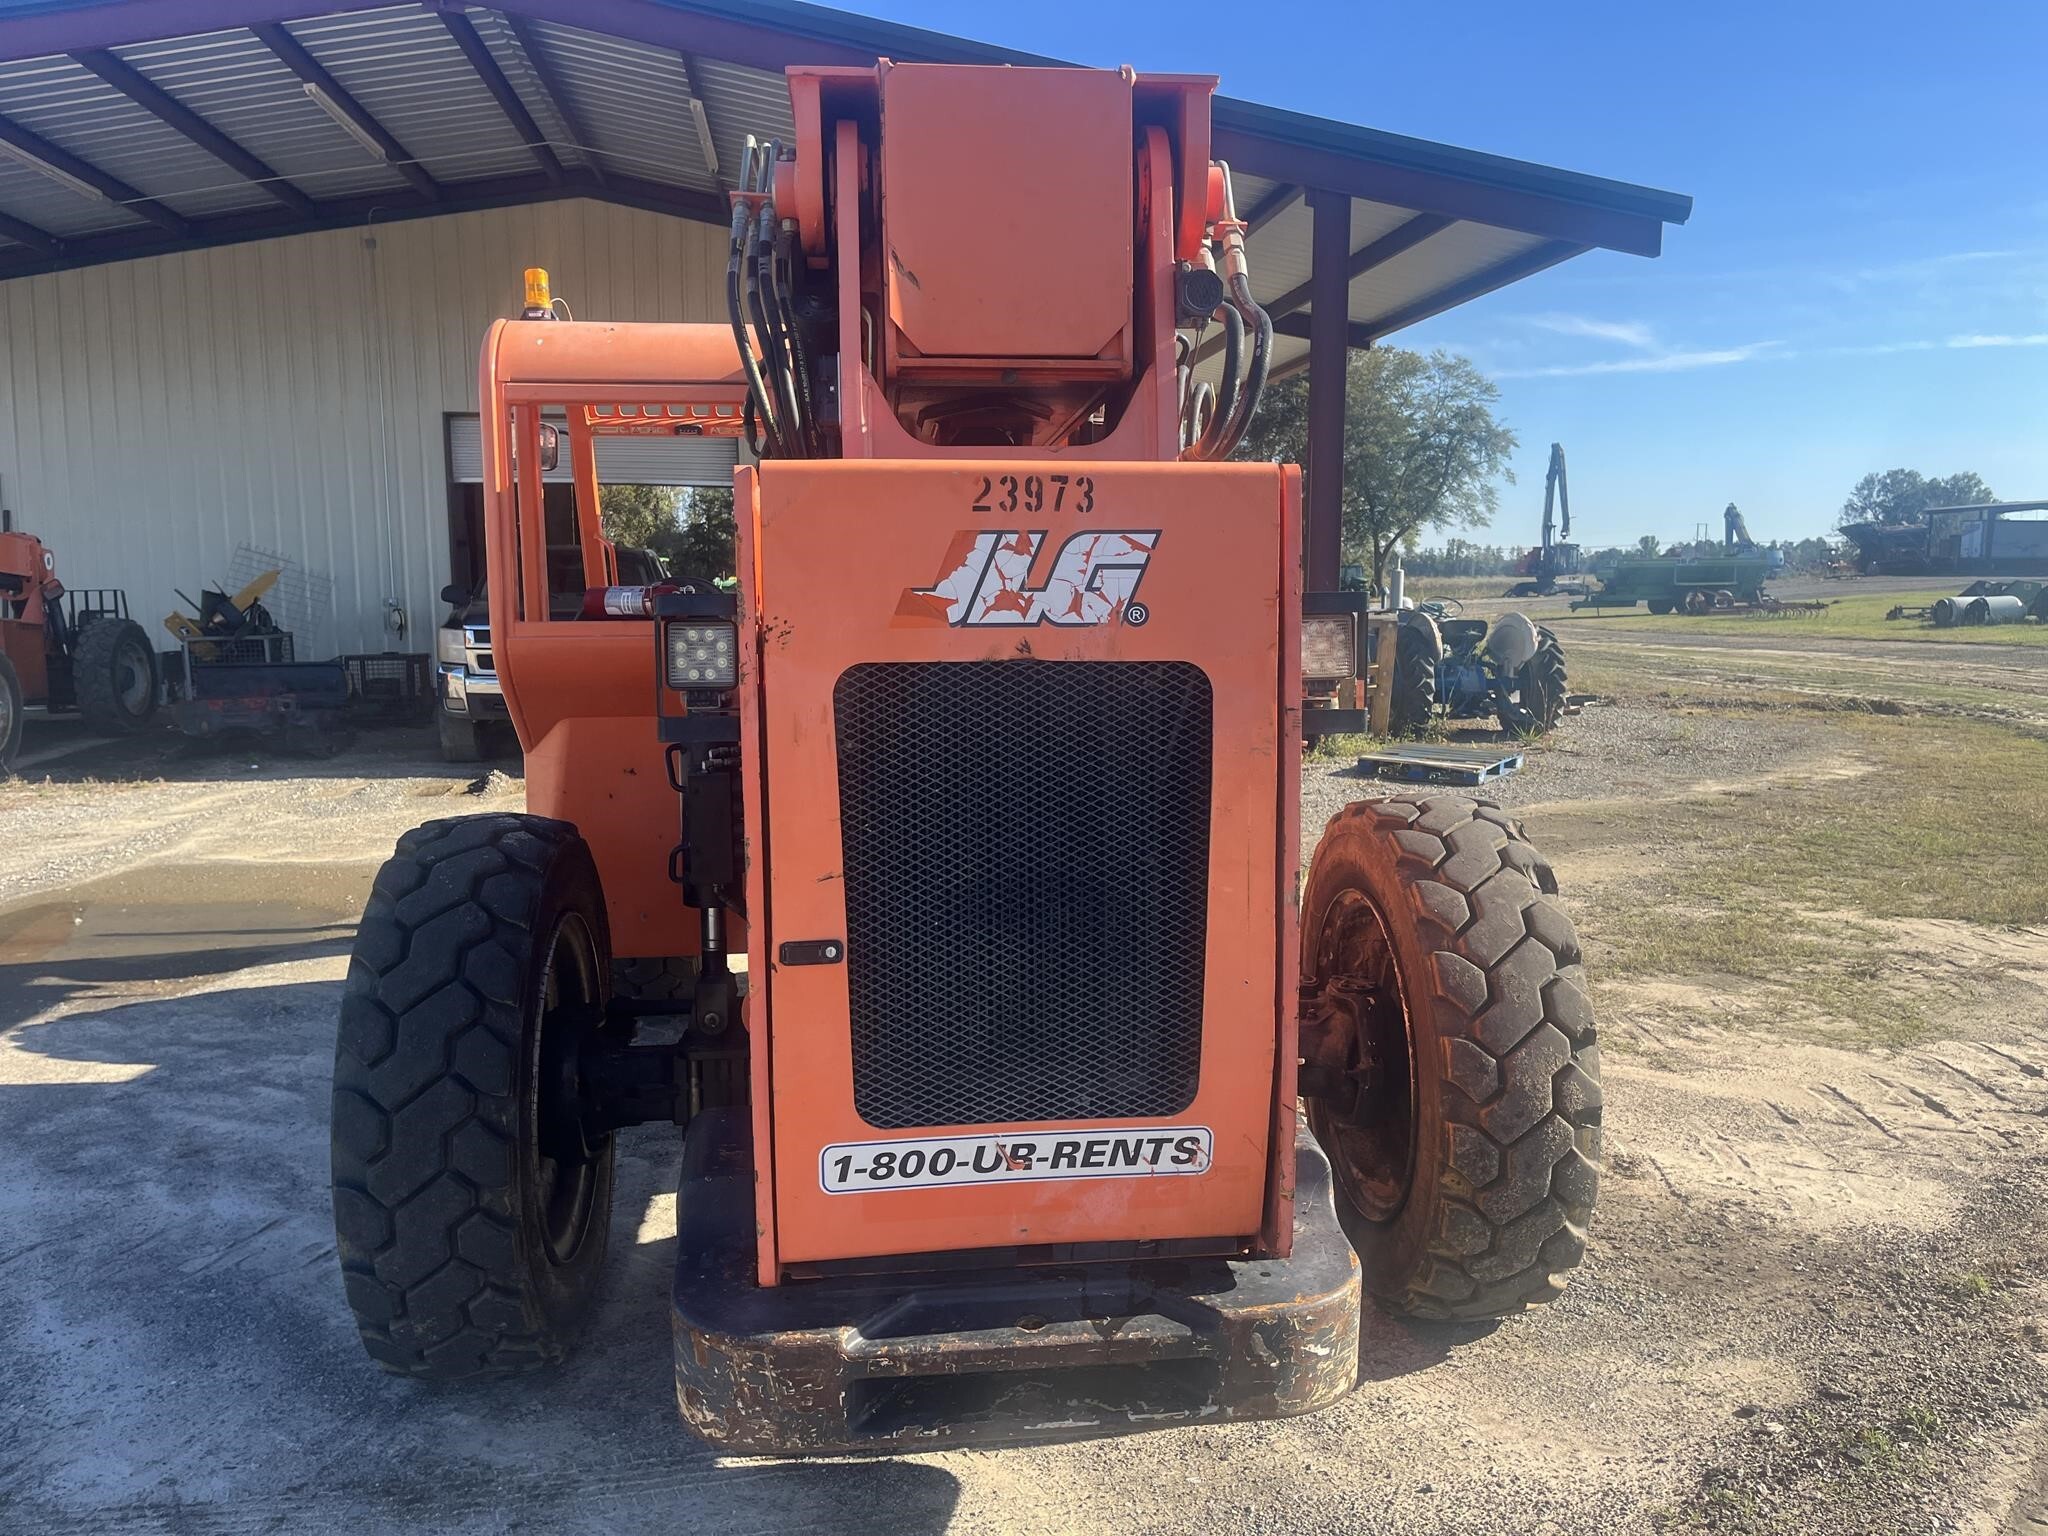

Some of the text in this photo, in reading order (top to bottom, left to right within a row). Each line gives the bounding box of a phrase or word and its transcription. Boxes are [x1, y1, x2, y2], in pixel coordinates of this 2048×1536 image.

[971, 475, 1095, 513] 23973
[903, 529, 1162, 627] JLG
[832, 1136, 1201, 1183] 1-800-UR-RENTS
